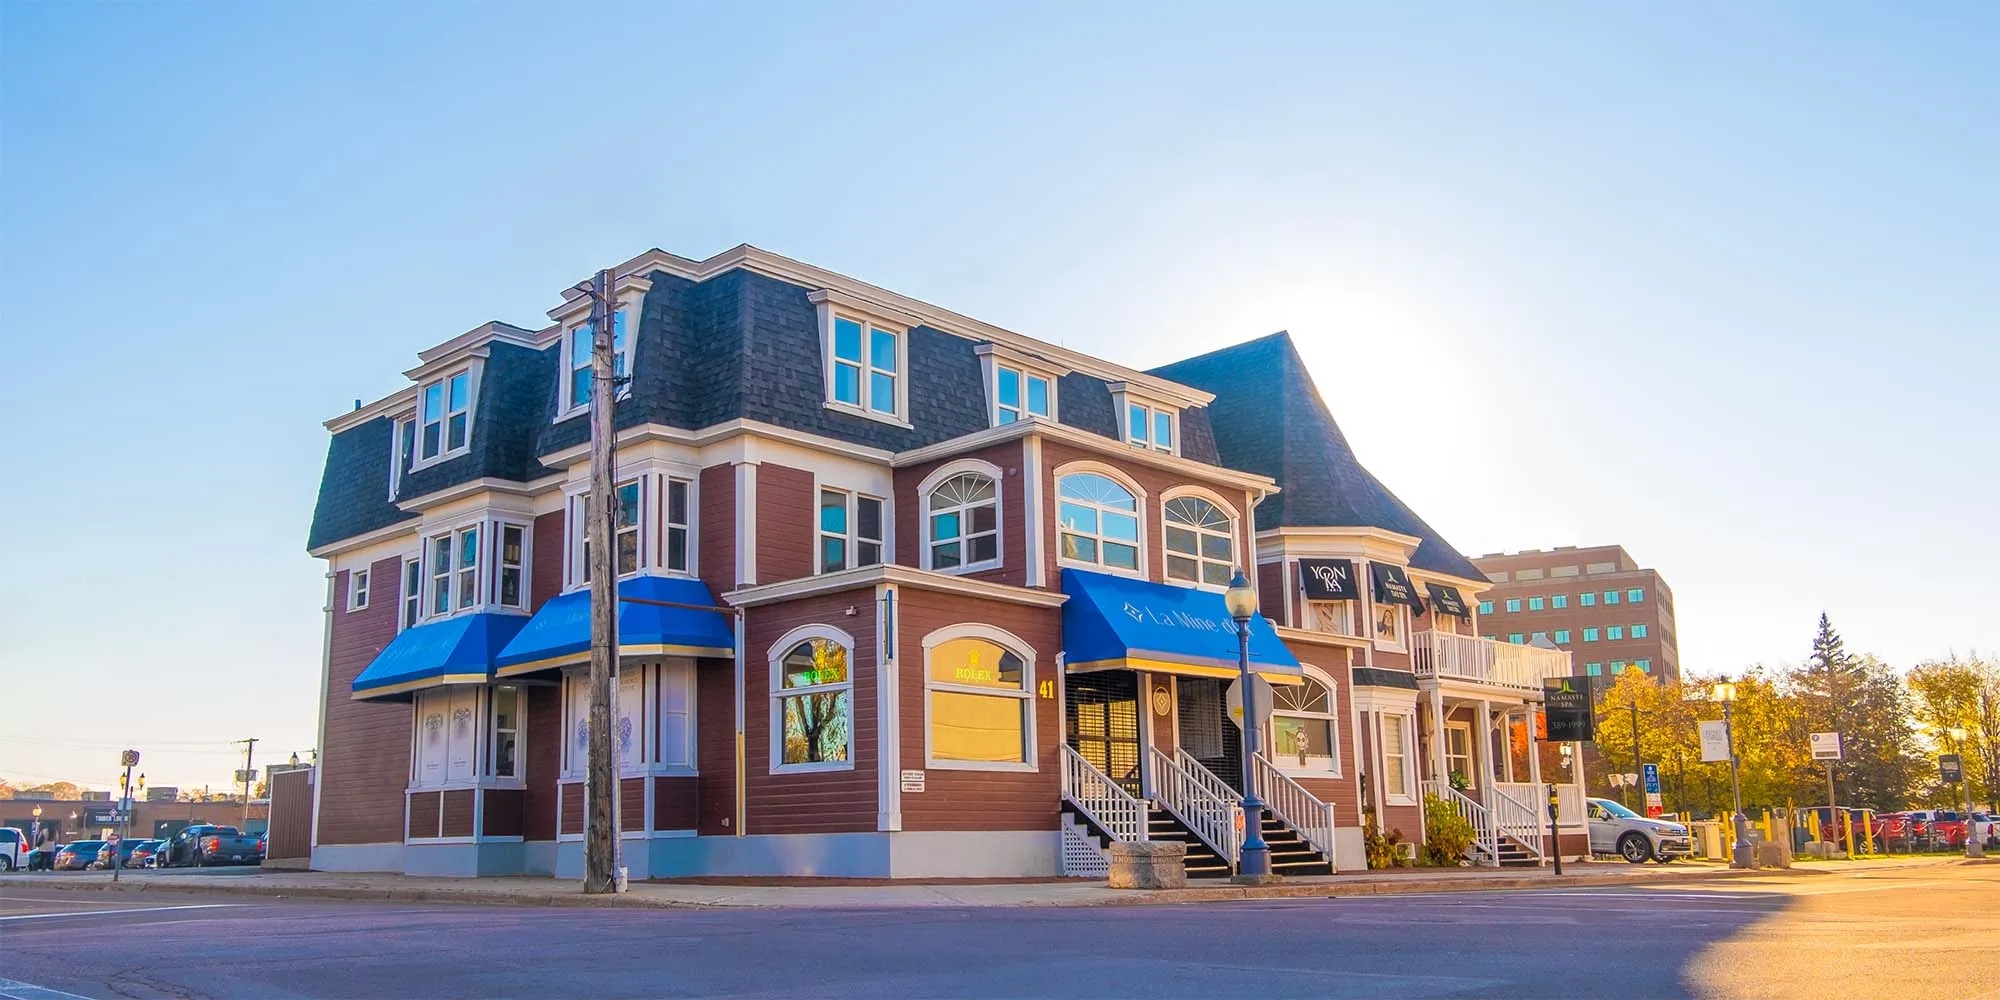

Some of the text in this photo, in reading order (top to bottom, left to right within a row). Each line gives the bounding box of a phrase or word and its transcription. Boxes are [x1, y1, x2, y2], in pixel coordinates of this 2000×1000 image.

[1384, 582, 1408, 593] NAMASTE
[1145, 606, 1175, 626] La
[1171, 609, 1219, 632] Mine
[804, 668, 838, 681] ROLEX
[955, 667, 992, 681] ROLEX
[1040, 680, 1054, 699] 41
